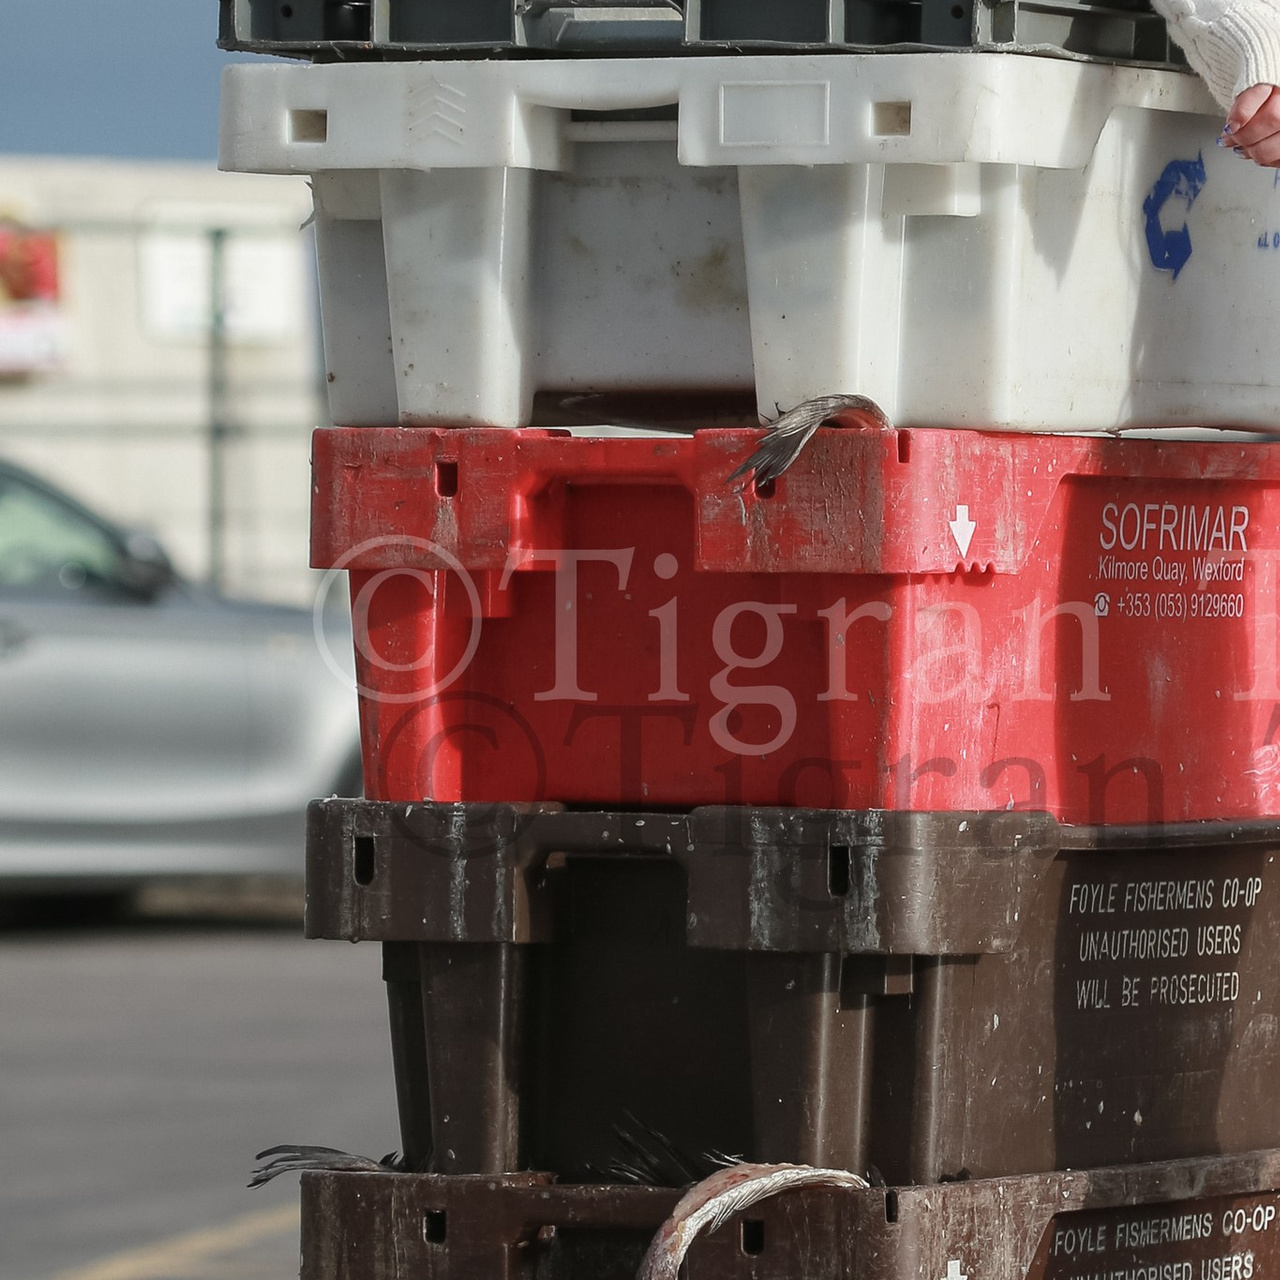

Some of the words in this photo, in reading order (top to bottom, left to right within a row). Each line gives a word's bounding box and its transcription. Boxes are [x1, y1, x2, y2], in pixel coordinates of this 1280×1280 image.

[1100, 502, 1250, 553] SOFRIMAR
[1098, 555, 1149, 580] Kilmore
[1152, 555, 1188, 586] Quay,
[1192, 556, 1244, 581] Wexford
[1117, 592, 1151, 617] +353
[1154, 592, 1188, 621] (053)
[1190, 592, 1244, 618] 9129660
[1069, 883, 1118, 914] FOYLE
[1124, 879, 1215, 912] FISHERMENS
[1222, 877, 1262, 908] CO-OP
[1079, 927, 1189, 962] UNAUTHORISED
[1197, 924, 1242, 957] USERS
[1076, 978, 1110, 1009] WILL
[1121, 975, 1140, 1007] BE
[1150, 972, 1239, 1005] PROSECUTED
[1054, 1226, 1106, 1256] FOYLE
[1115, 1212, 1213, 1249] FISHERMENS
[1222, 1205, 1275, 1236] CO-OP
